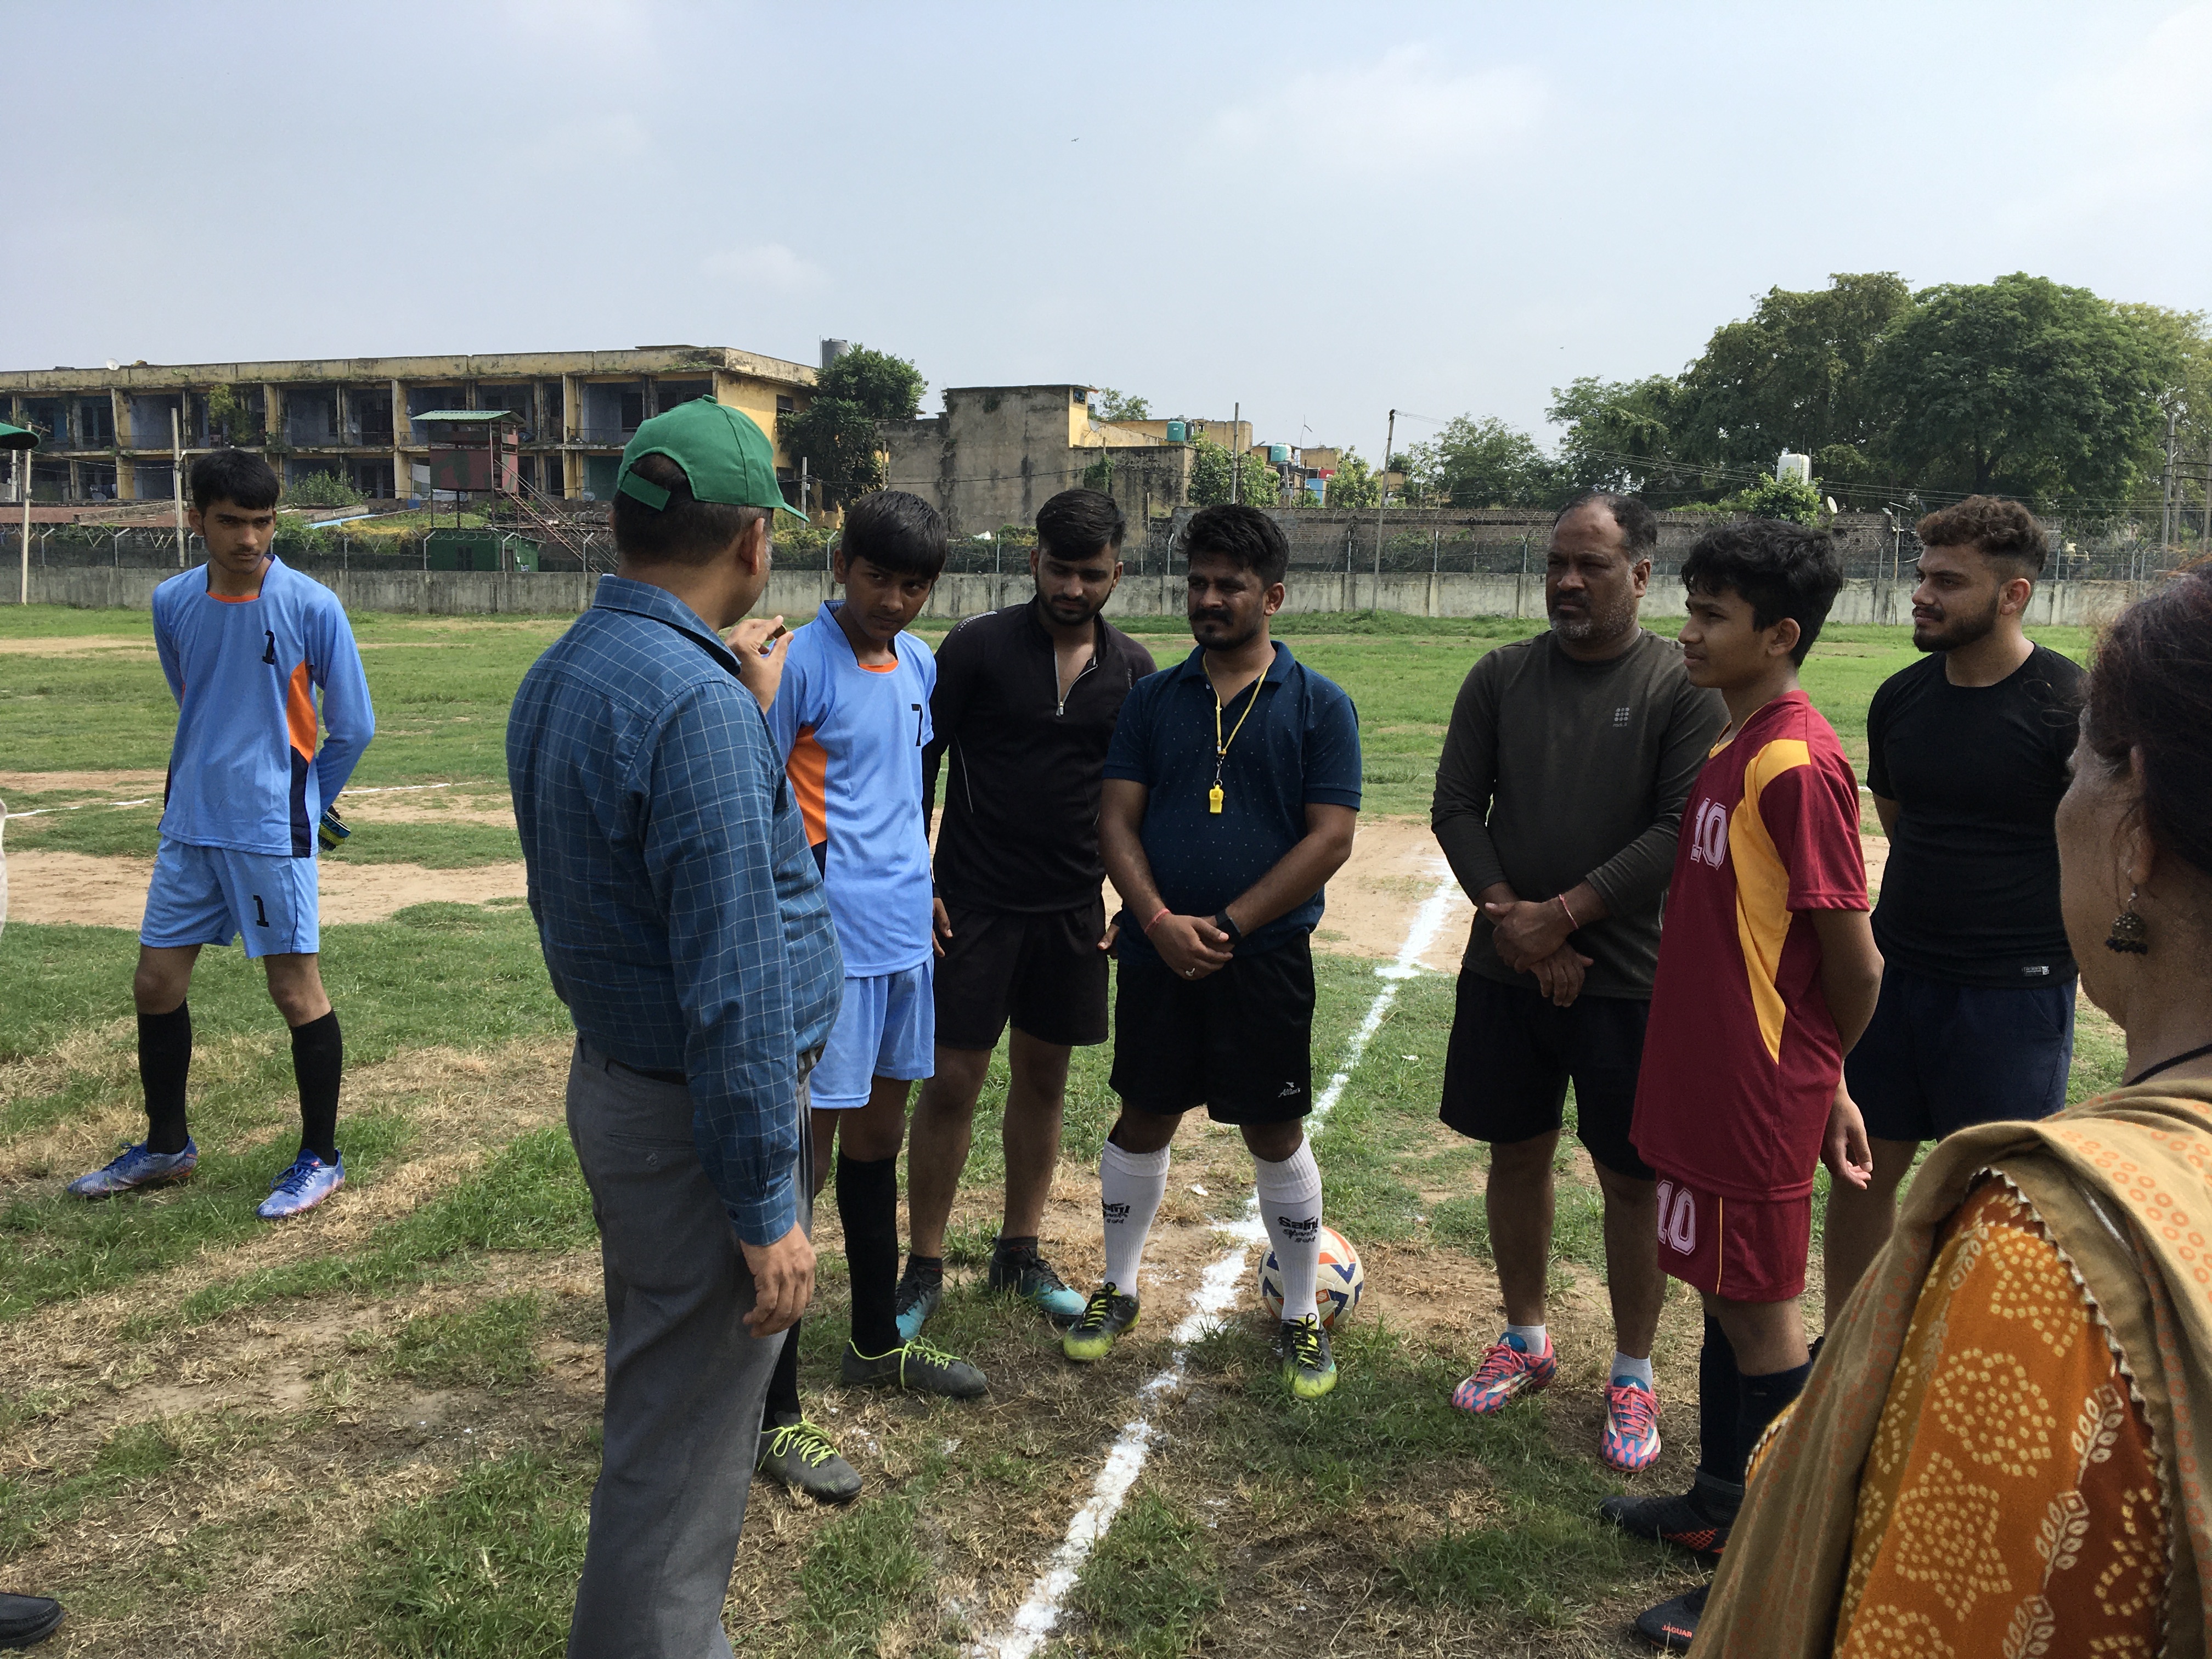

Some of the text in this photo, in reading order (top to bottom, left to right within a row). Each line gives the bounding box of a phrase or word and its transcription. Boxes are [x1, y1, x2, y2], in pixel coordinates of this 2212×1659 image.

[262, 630, 275, 665] 1
[911, 704, 923, 747] 7
[1690, 797, 1729, 871] 10
[253, 895, 269, 927] 1
[1657, 1180, 1696, 1256] 10
[1662, 1625, 1692, 1639] JAGUAR
